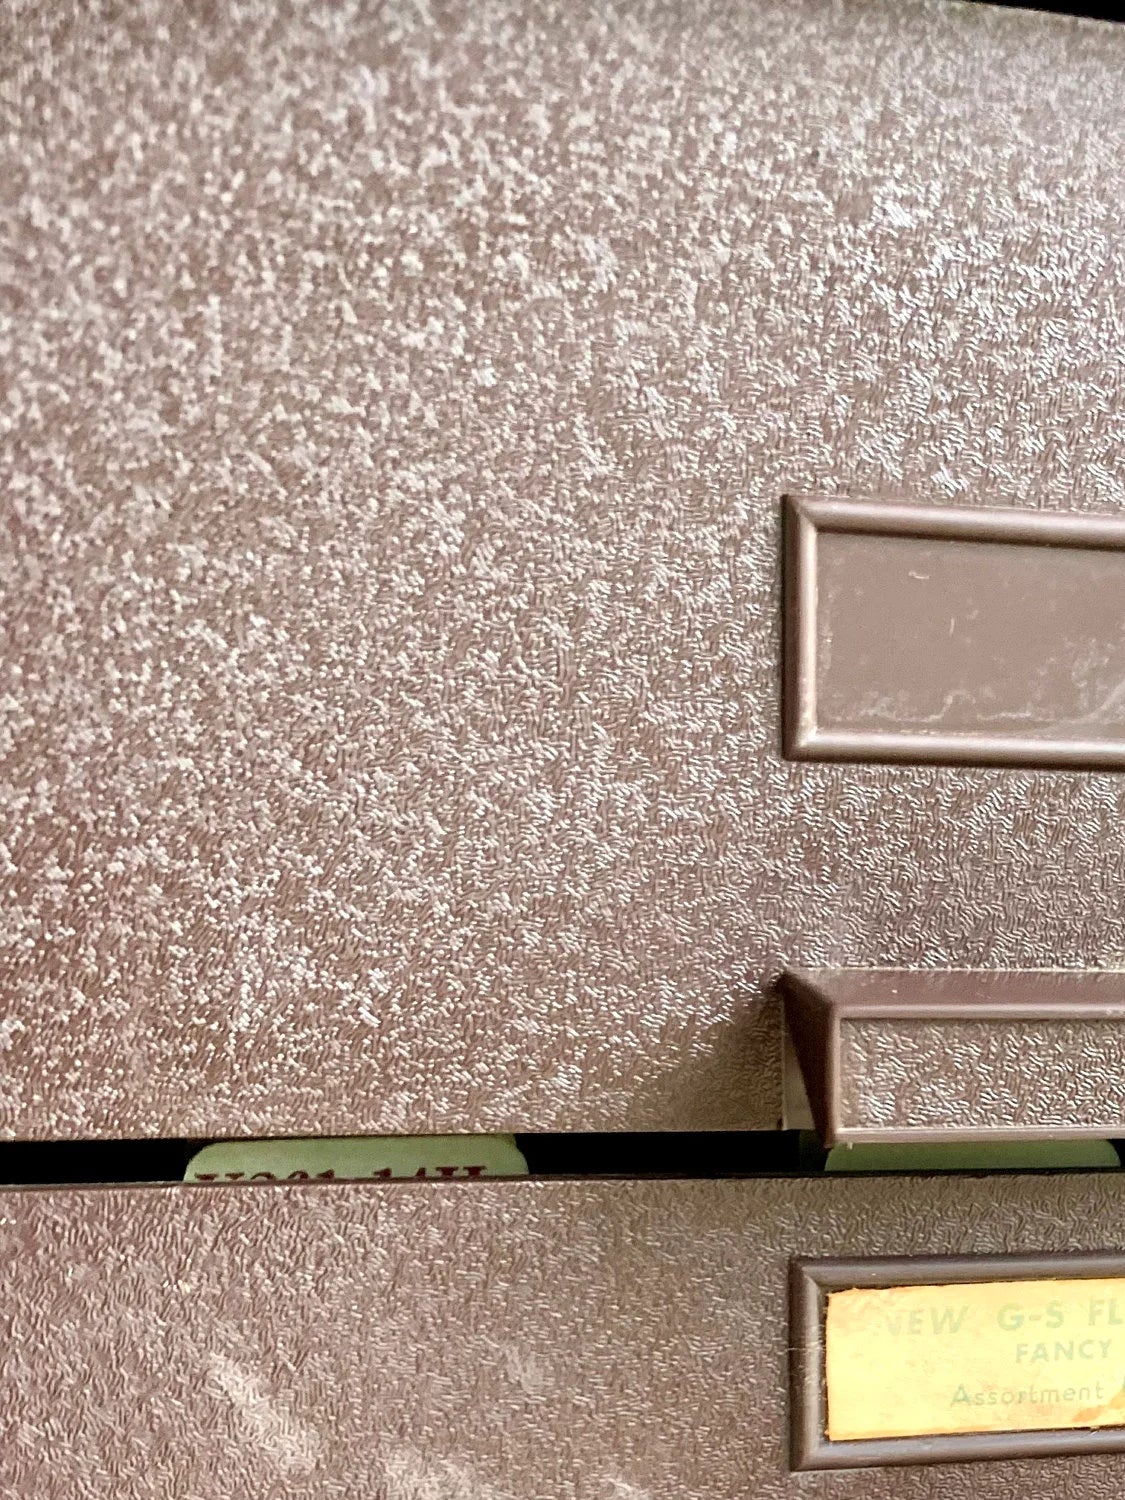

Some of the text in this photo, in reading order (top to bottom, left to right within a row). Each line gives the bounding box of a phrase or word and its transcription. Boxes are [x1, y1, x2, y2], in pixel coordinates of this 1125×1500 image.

[996, 1300, 1066, 1332] G-S
[1015, 1338, 1113, 1364] FANCY
[950, 1380, 1105, 1408] Assortment
